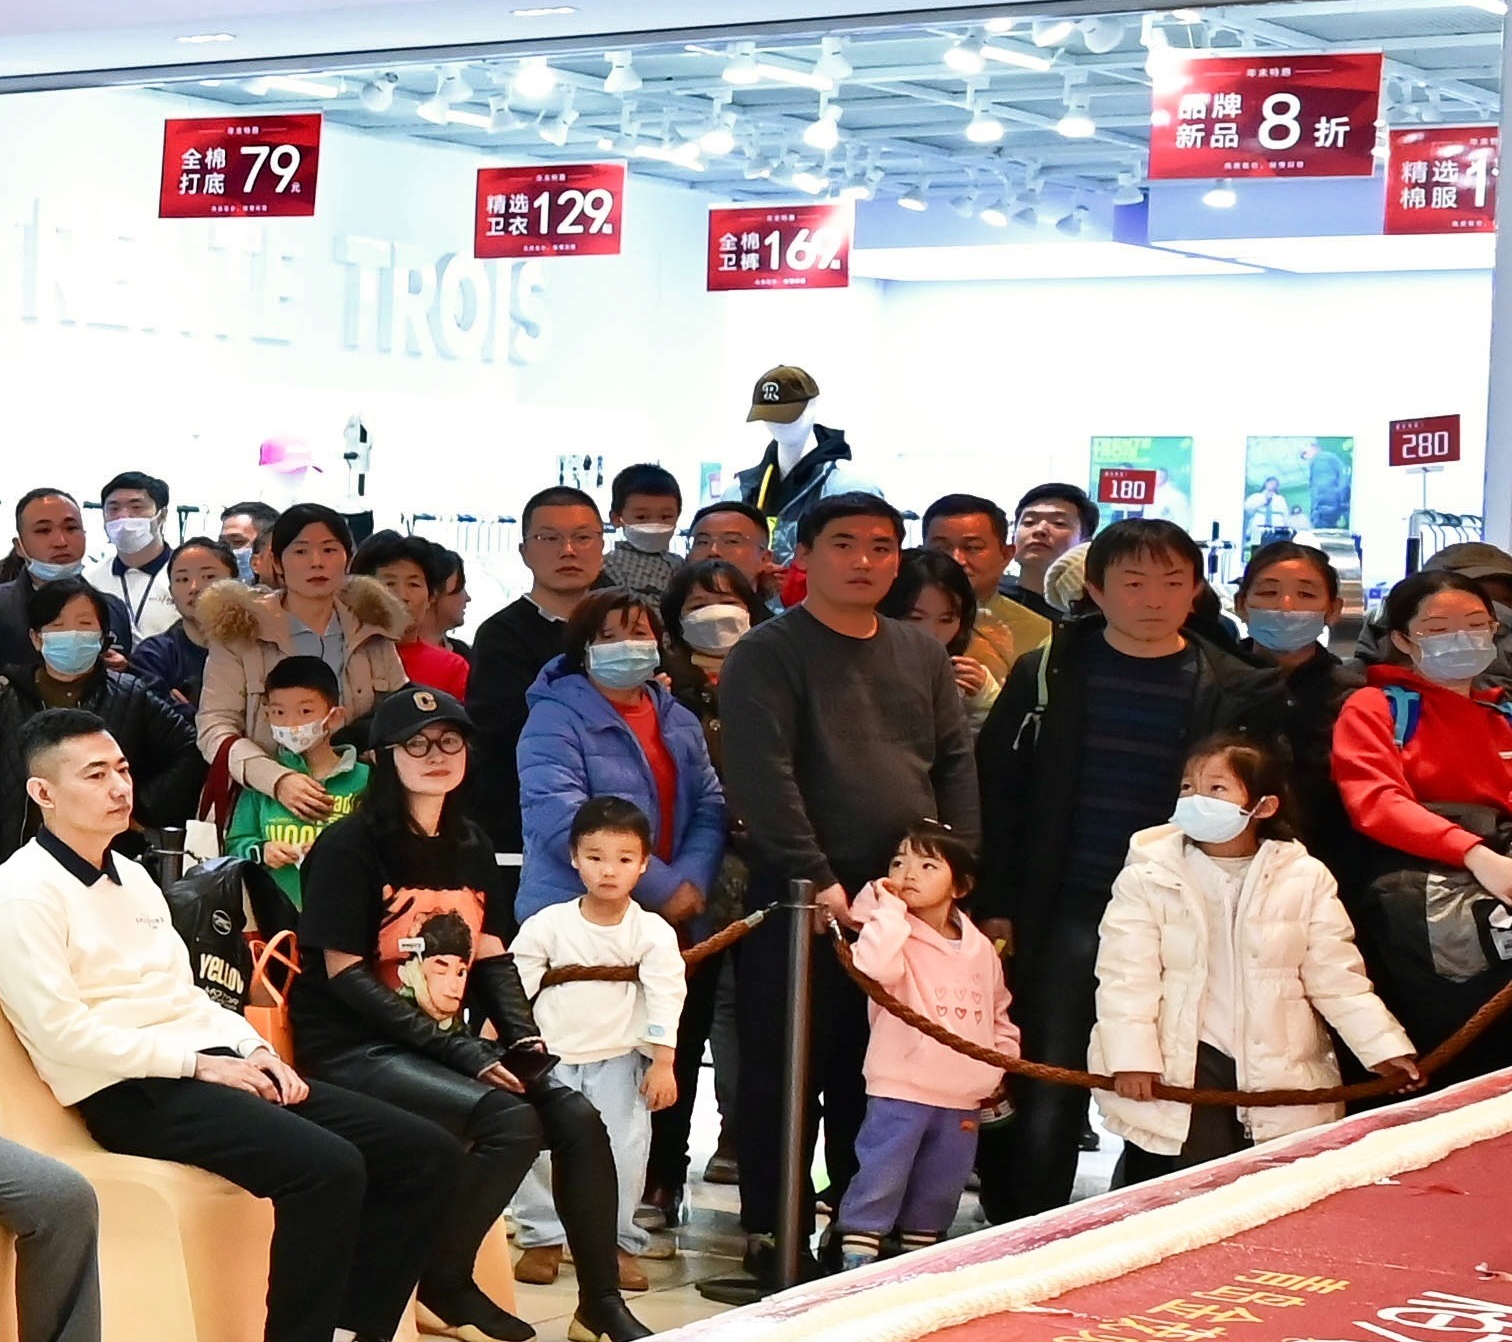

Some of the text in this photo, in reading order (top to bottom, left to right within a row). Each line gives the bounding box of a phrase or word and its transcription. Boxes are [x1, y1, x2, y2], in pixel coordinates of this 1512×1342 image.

[1177, 92, 1243, 120] 品牌
[1175, 122, 1240, 149] 新品
[180, 146, 227, 170] 全棉
[179, 173, 226, 195] 打底
[1401, 160, 1459, 184] 精选
[485, 194, 530, 215] 精选
[1399, 186, 1458, 210] 棉服
[485, 216, 529, 236] 卫衣
[718, 231, 761, 252] 全棉
[334, 235, 552, 367] TROIS
[1401, 431, 1449, 459] 280
[1109, 479, 1146, 500] 180
